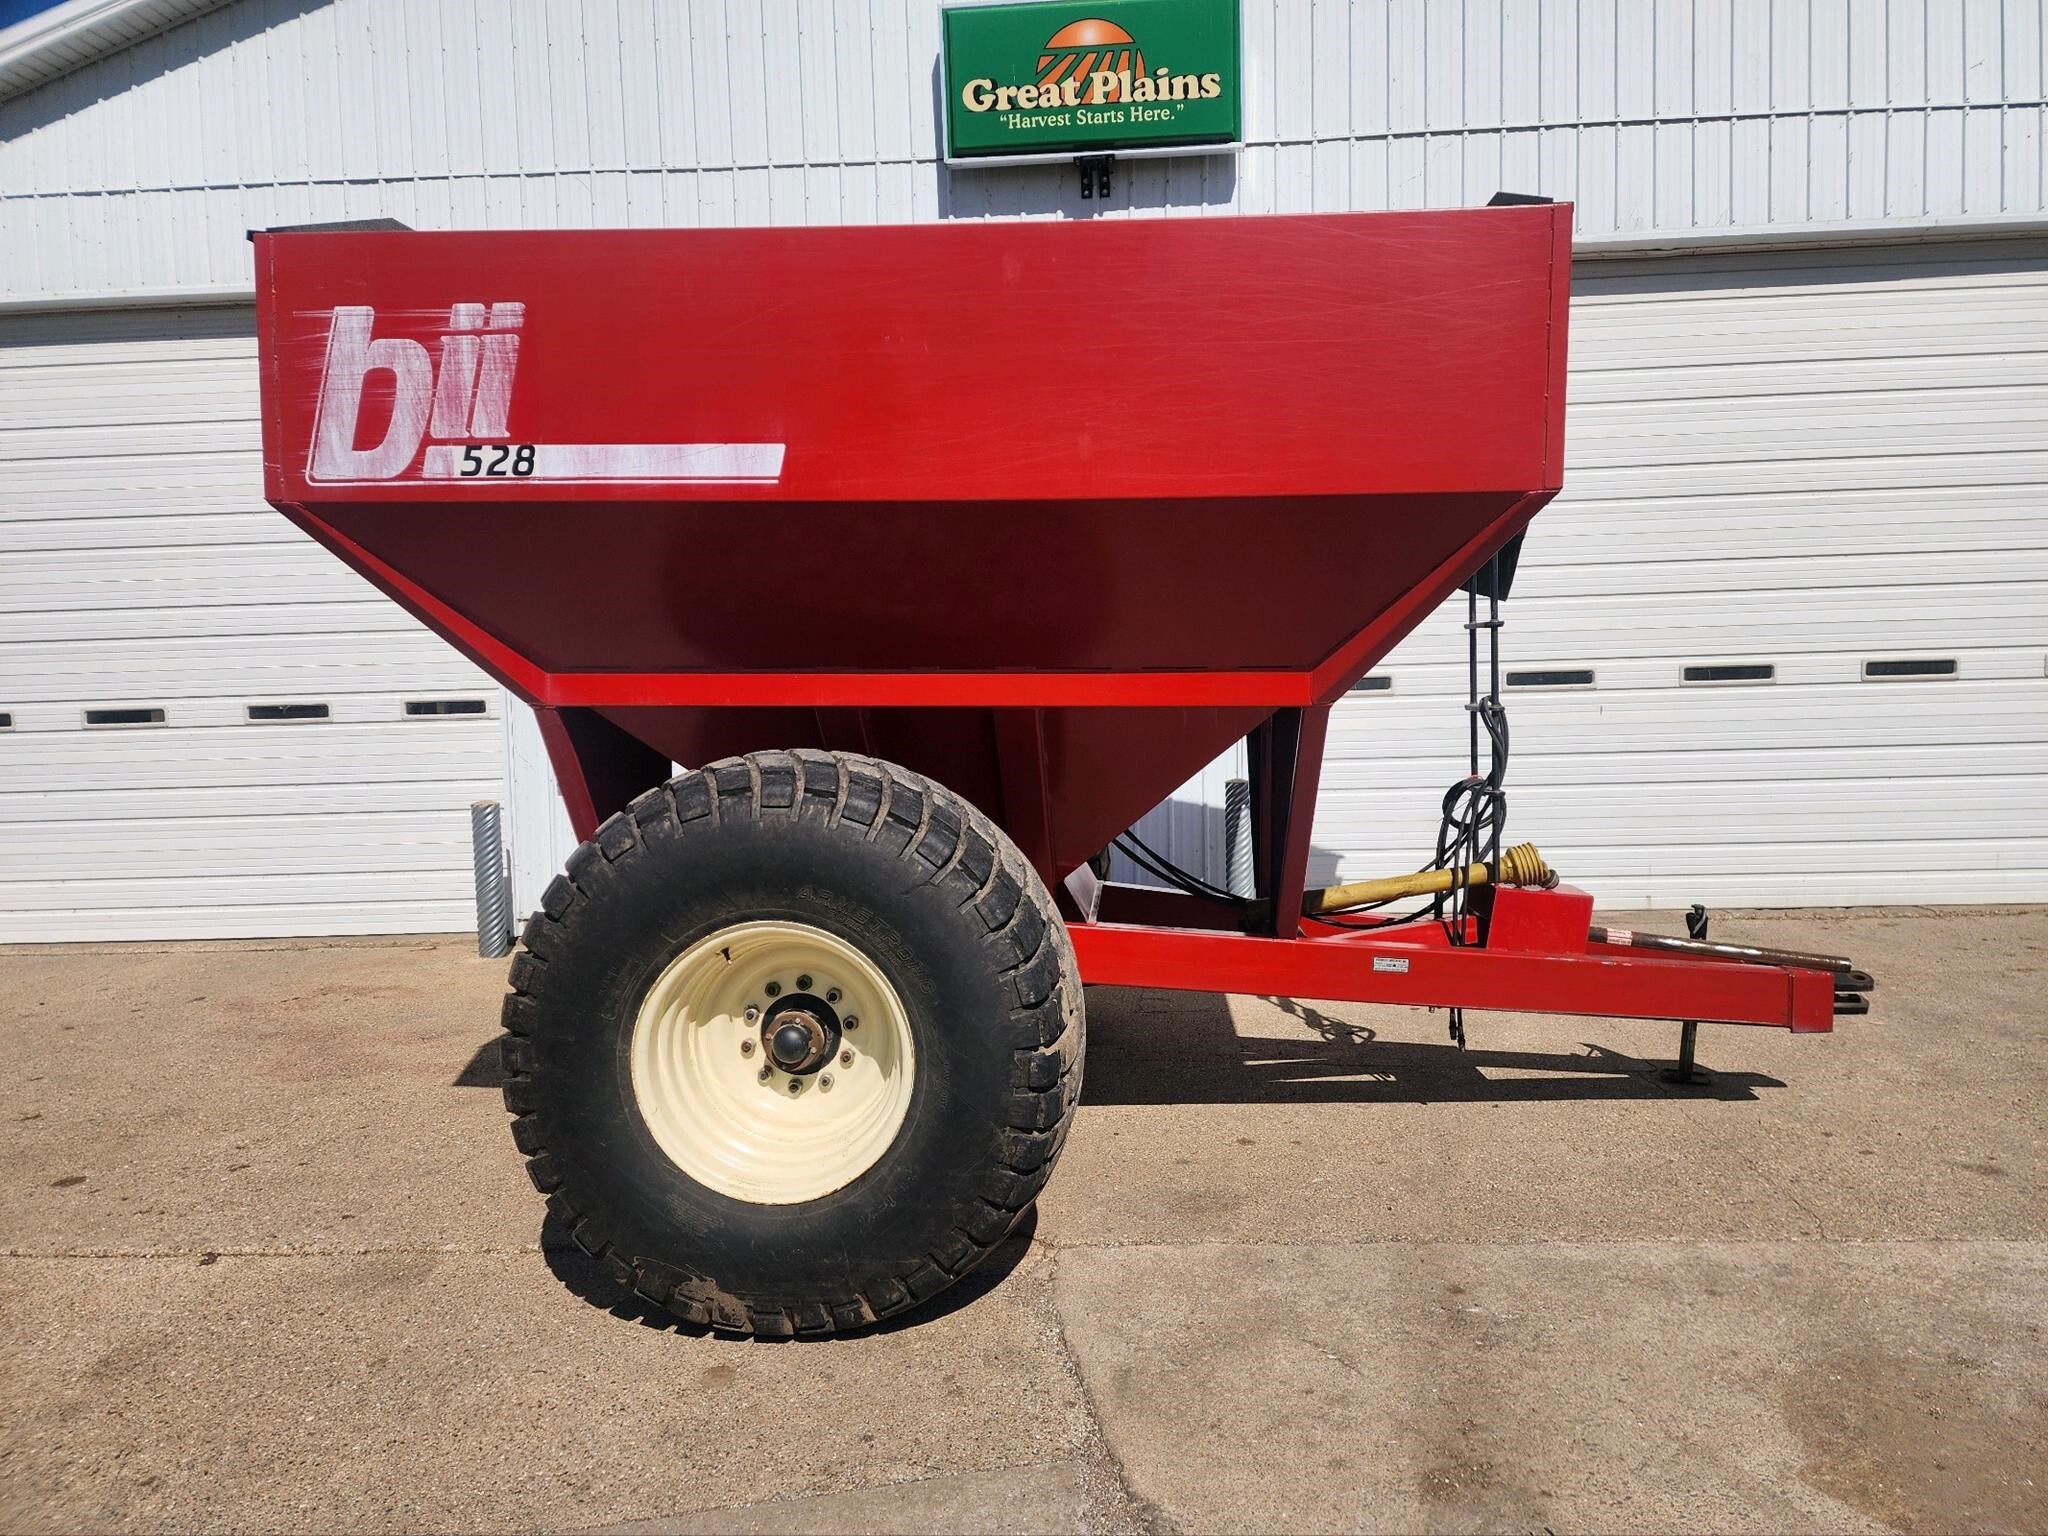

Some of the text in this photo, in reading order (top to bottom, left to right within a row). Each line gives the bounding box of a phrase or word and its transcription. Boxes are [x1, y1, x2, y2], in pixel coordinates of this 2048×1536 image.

[962, 67, 1222, 112] Great Plains
[1076, 107, 1125, 125] Starts
[460, 445, 536, 476] 528
[795, 885, 937, 995] ARMSTRONG
